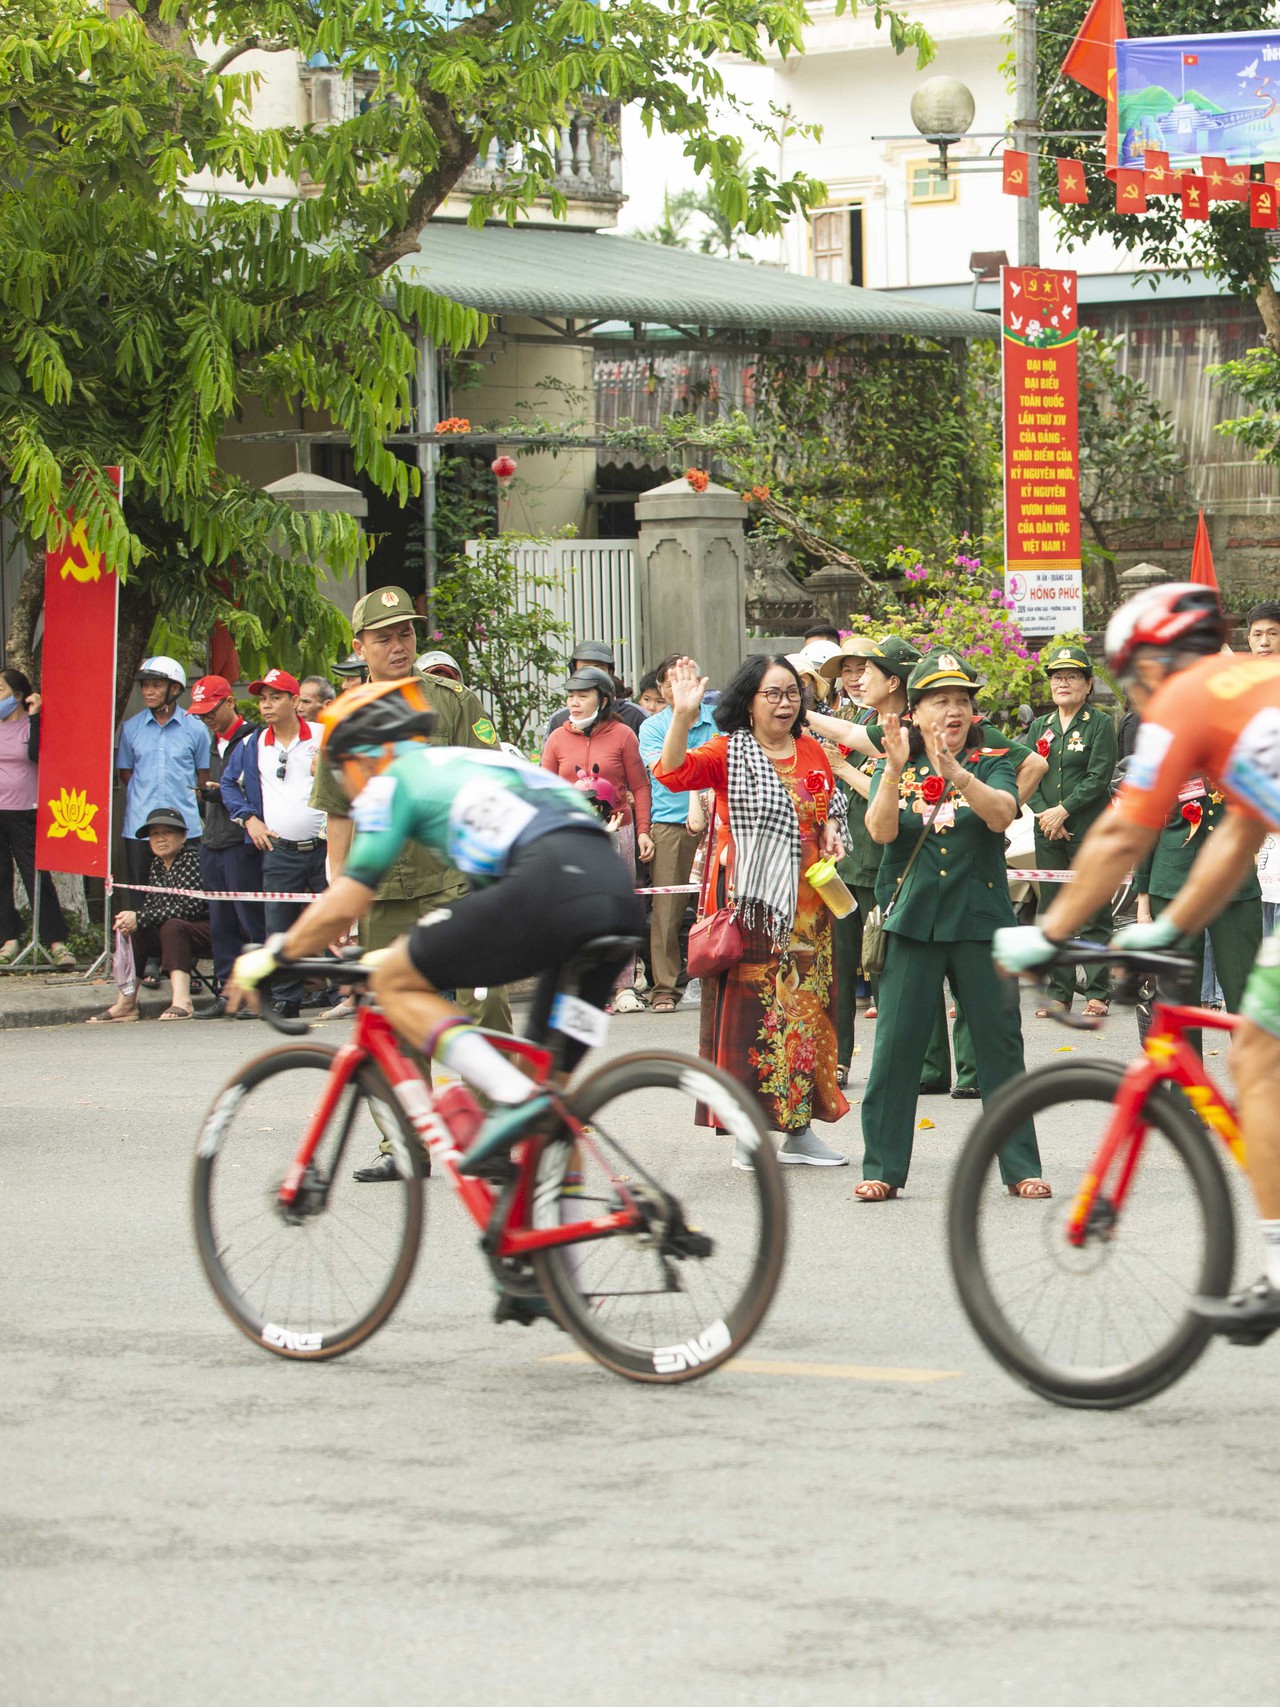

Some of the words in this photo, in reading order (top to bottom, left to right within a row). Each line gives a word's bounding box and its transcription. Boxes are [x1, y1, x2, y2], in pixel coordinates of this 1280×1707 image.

[1027, 359, 1041, 373] ĐẠI
[1042, 358, 1057, 374] HỘI
[1025, 377, 1039, 391] ĐẠI
[1040, 374, 1060, 390] BIỂU
[1019, 393, 1041, 407] TOÀN
[1042, 392, 1065, 408] QUỐC
[1036, 412, 1052, 425] THỨ
[1053, 414, 1067, 426] XIV
[1020, 428, 1036, 443] CỦA
[1037, 428, 1060, 443] ĐẢNG
[1013, 447, 1032, 462] KHỞI
[1033, 446, 1055, 462] ĐIỂM
[1056, 447, 1073, 462] CỦA
[1010, 464, 1022, 480] KỶ
[1023, 466, 1056, 480] NGUYÊN
[1057, 466, 1075, 481] MỚI,
[1021, 482, 1032, 498] KỶ
[1033, 484, 1066, 498] NGUYÊN
[1021, 503, 1043, 516] VƯƠN
[1044, 502, 1067, 516] MÌNH
[1017, 518, 1035, 534] CỦA
[1036, 520, 1053, 534] DÂN
[1054, 520, 1070, 536] TỘC
[1022, 538, 1040, 555] VIỆT
[1041, 540, 1061, 552] NAM
[1030, 585, 1056, 600] HỒNG
[1058, 584, 1080, 599] PHÚC
